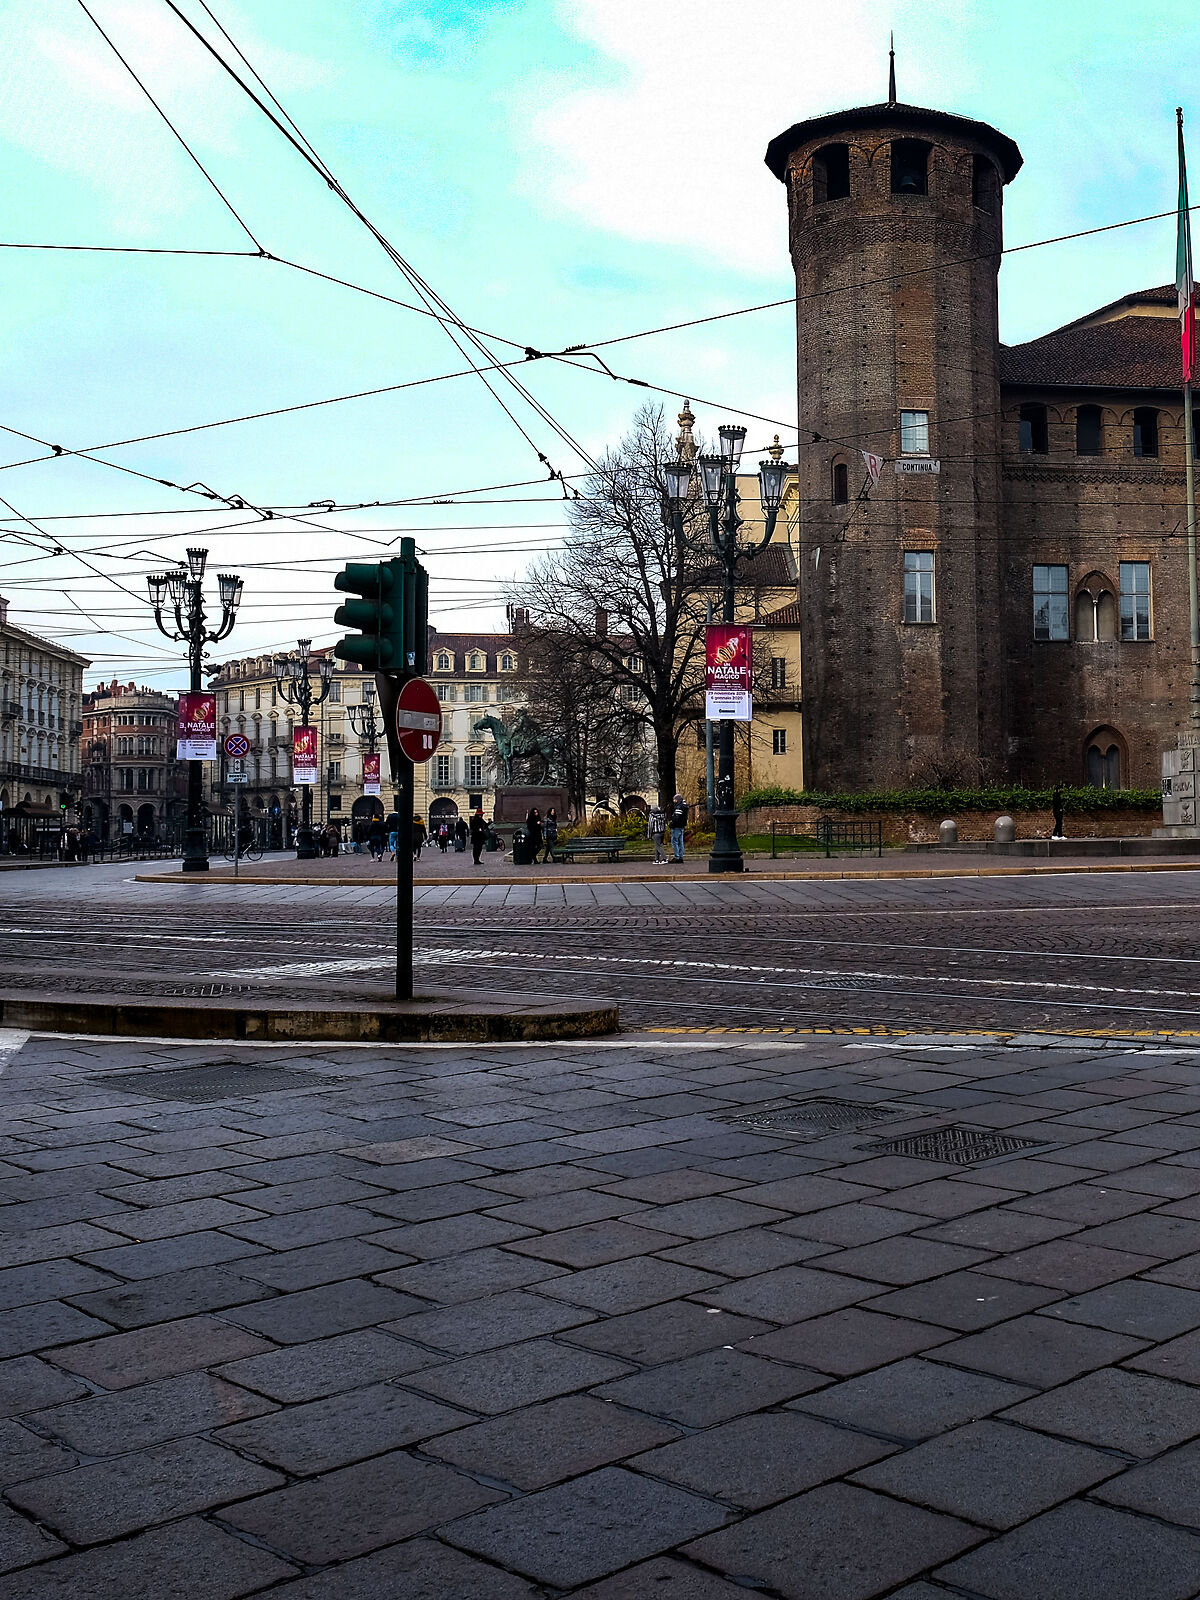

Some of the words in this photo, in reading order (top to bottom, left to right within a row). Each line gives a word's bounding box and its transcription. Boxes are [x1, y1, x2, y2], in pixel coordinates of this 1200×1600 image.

[869, 454, 879, 477] R
[902, 463, 933, 471] CONTINUA
[707, 666, 747, 674] NATALE
